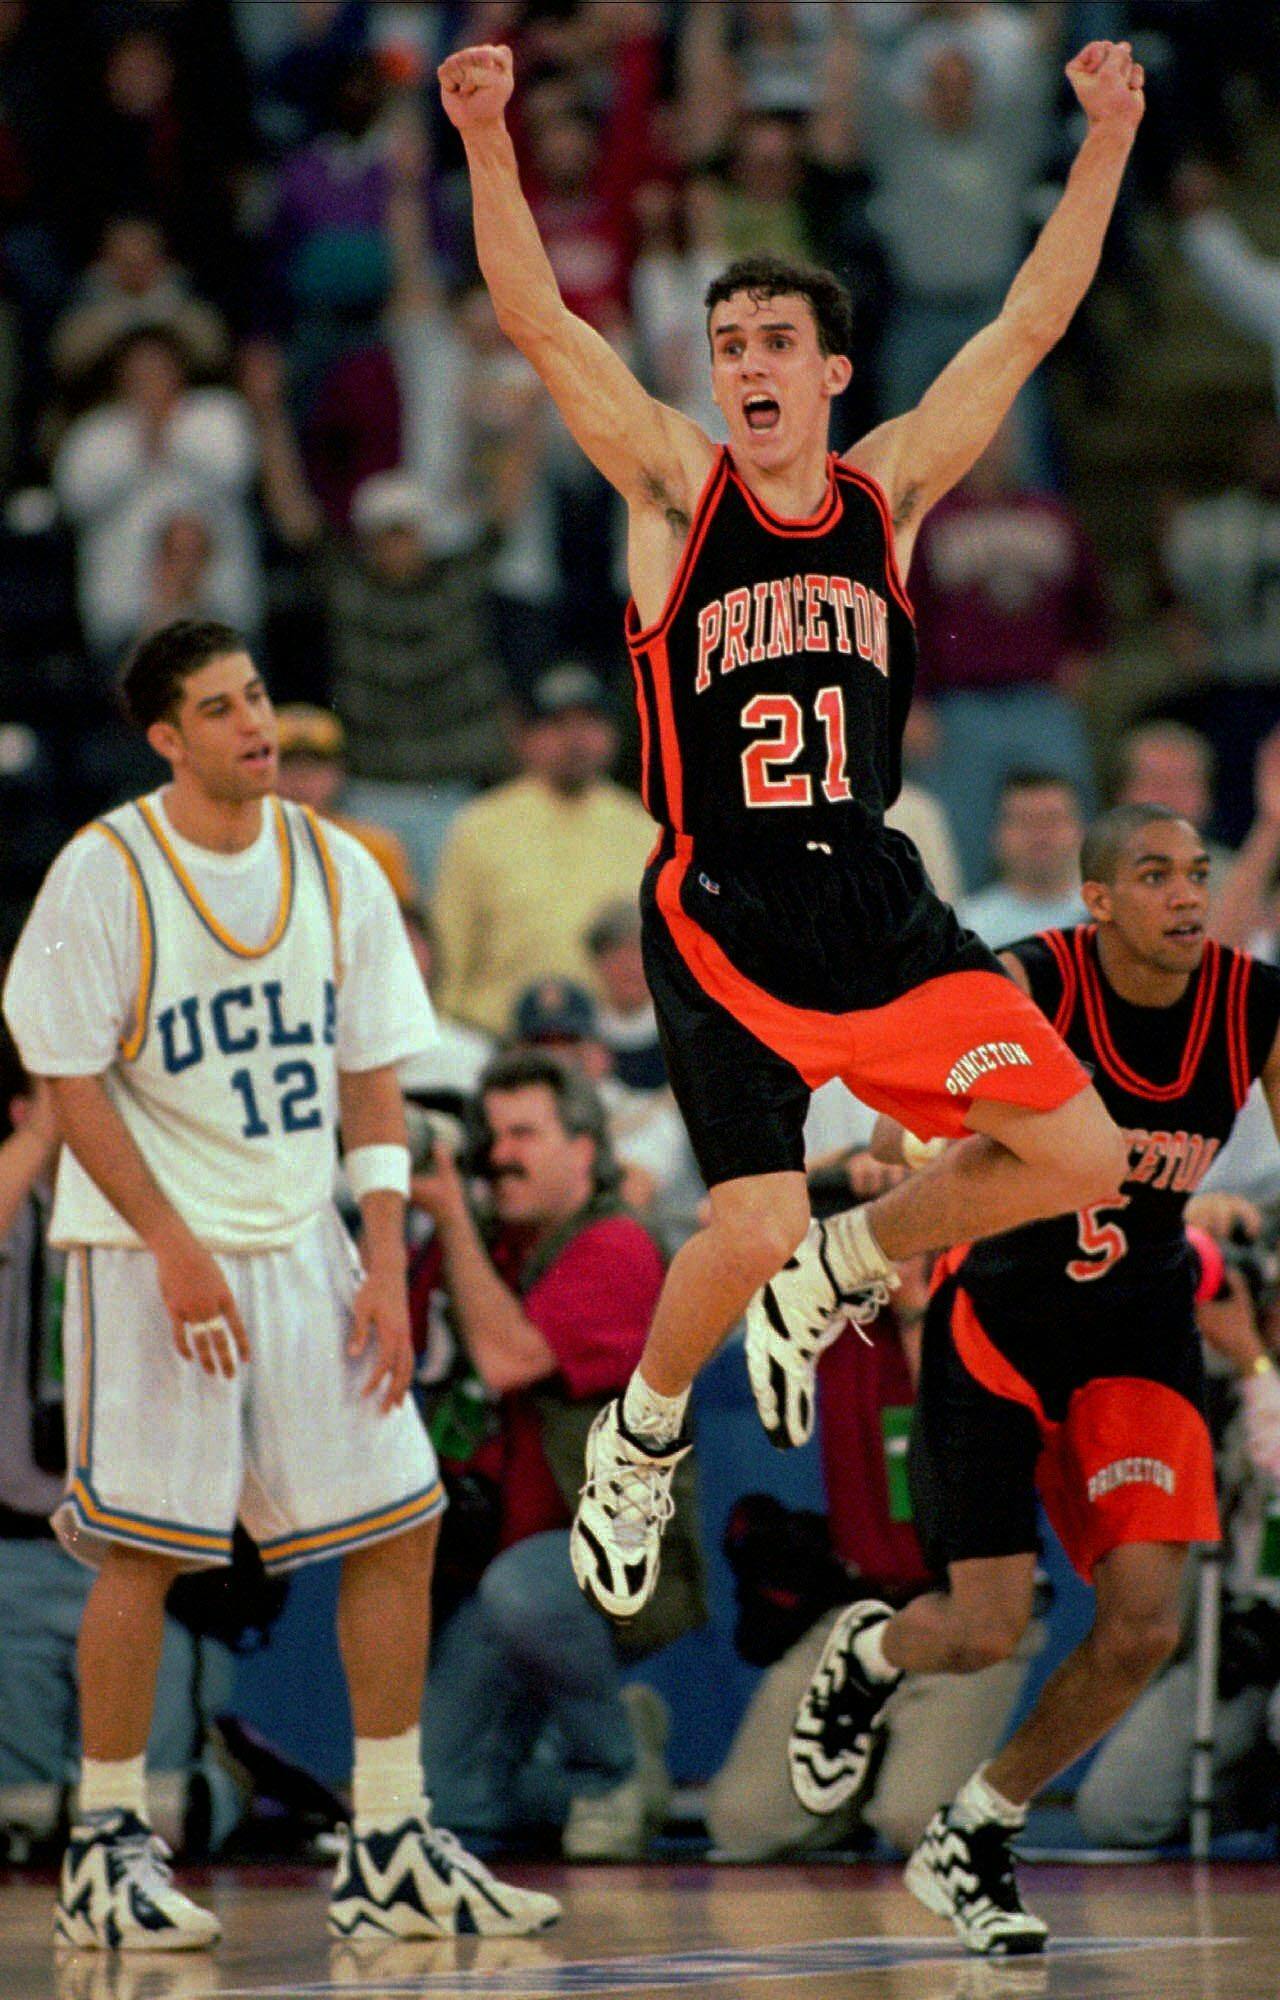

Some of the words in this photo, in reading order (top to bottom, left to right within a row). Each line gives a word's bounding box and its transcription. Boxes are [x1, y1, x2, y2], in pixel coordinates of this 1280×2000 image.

[696, 574, 888, 694] PRINCETON
[741, 687, 852, 807] 21
[231, 1059, 322, 1138] 12
[945, 1041, 1033, 1096] PRINCETON
[1065, 1196, 1131, 1282] 5
[1087, 1457, 1176, 1502] PRINCETON
